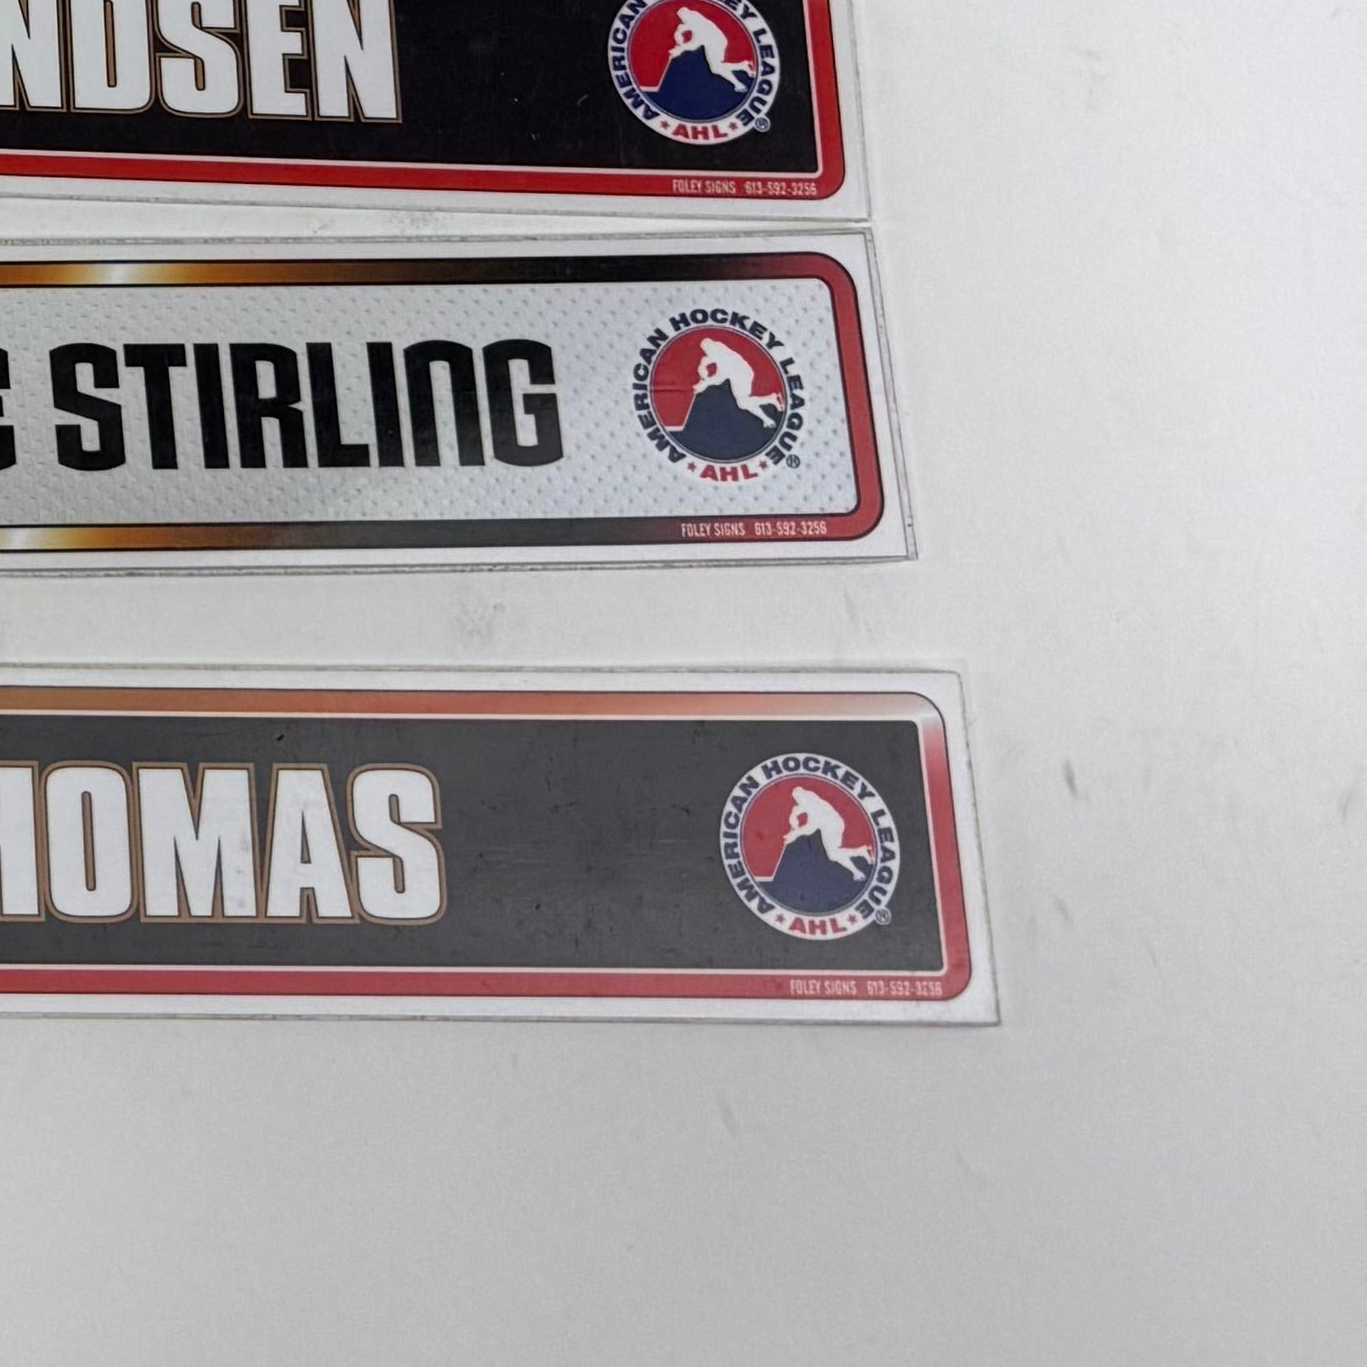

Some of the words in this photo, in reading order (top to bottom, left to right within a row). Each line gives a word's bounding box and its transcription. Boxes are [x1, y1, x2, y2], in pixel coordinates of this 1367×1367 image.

[736, 26, 775, 126] LEAGUE
[672, 124, 728, 140] AHL
[672, 179, 702, 193] FOLEY
[705, 180, 736, 194] SIGNS
[632, 329, 687, 463] AMERICAN
[669, 308, 784, 350] HOCKEY
[765, 357, 806, 466] LEAGUE
[49, 339, 564, 472] STIRLING
[700, 464, 758, 482] AHL
[681, 523, 711, 537] FOLEY
[714, 522, 746, 536] SIGNS
[723, 776, 774, 914] AMERICAN
[761, 757, 876, 801] HOCKEY
[854, 808, 897, 920] LEAGUE
[788, 917, 847, 935] AHL
